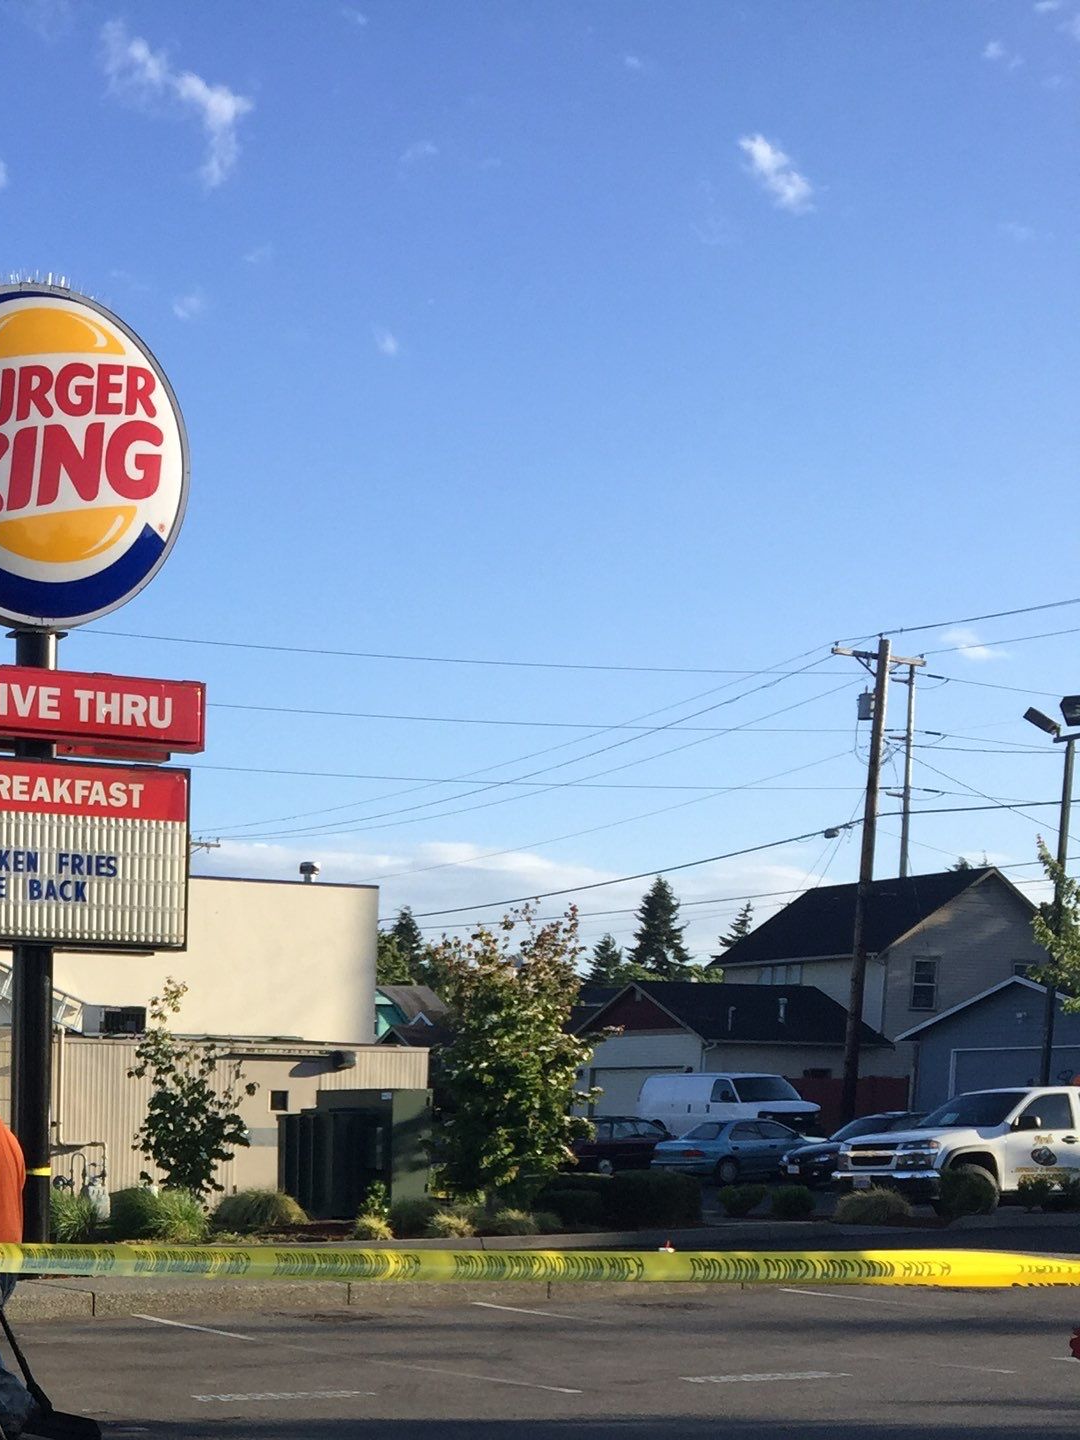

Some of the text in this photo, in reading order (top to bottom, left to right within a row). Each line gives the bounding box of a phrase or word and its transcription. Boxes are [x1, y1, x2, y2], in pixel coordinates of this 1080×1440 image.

[73, 688, 173, 729] THRU
[58, 852, 119, 878] FRIES
[29, 878, 88, 902] BACK
